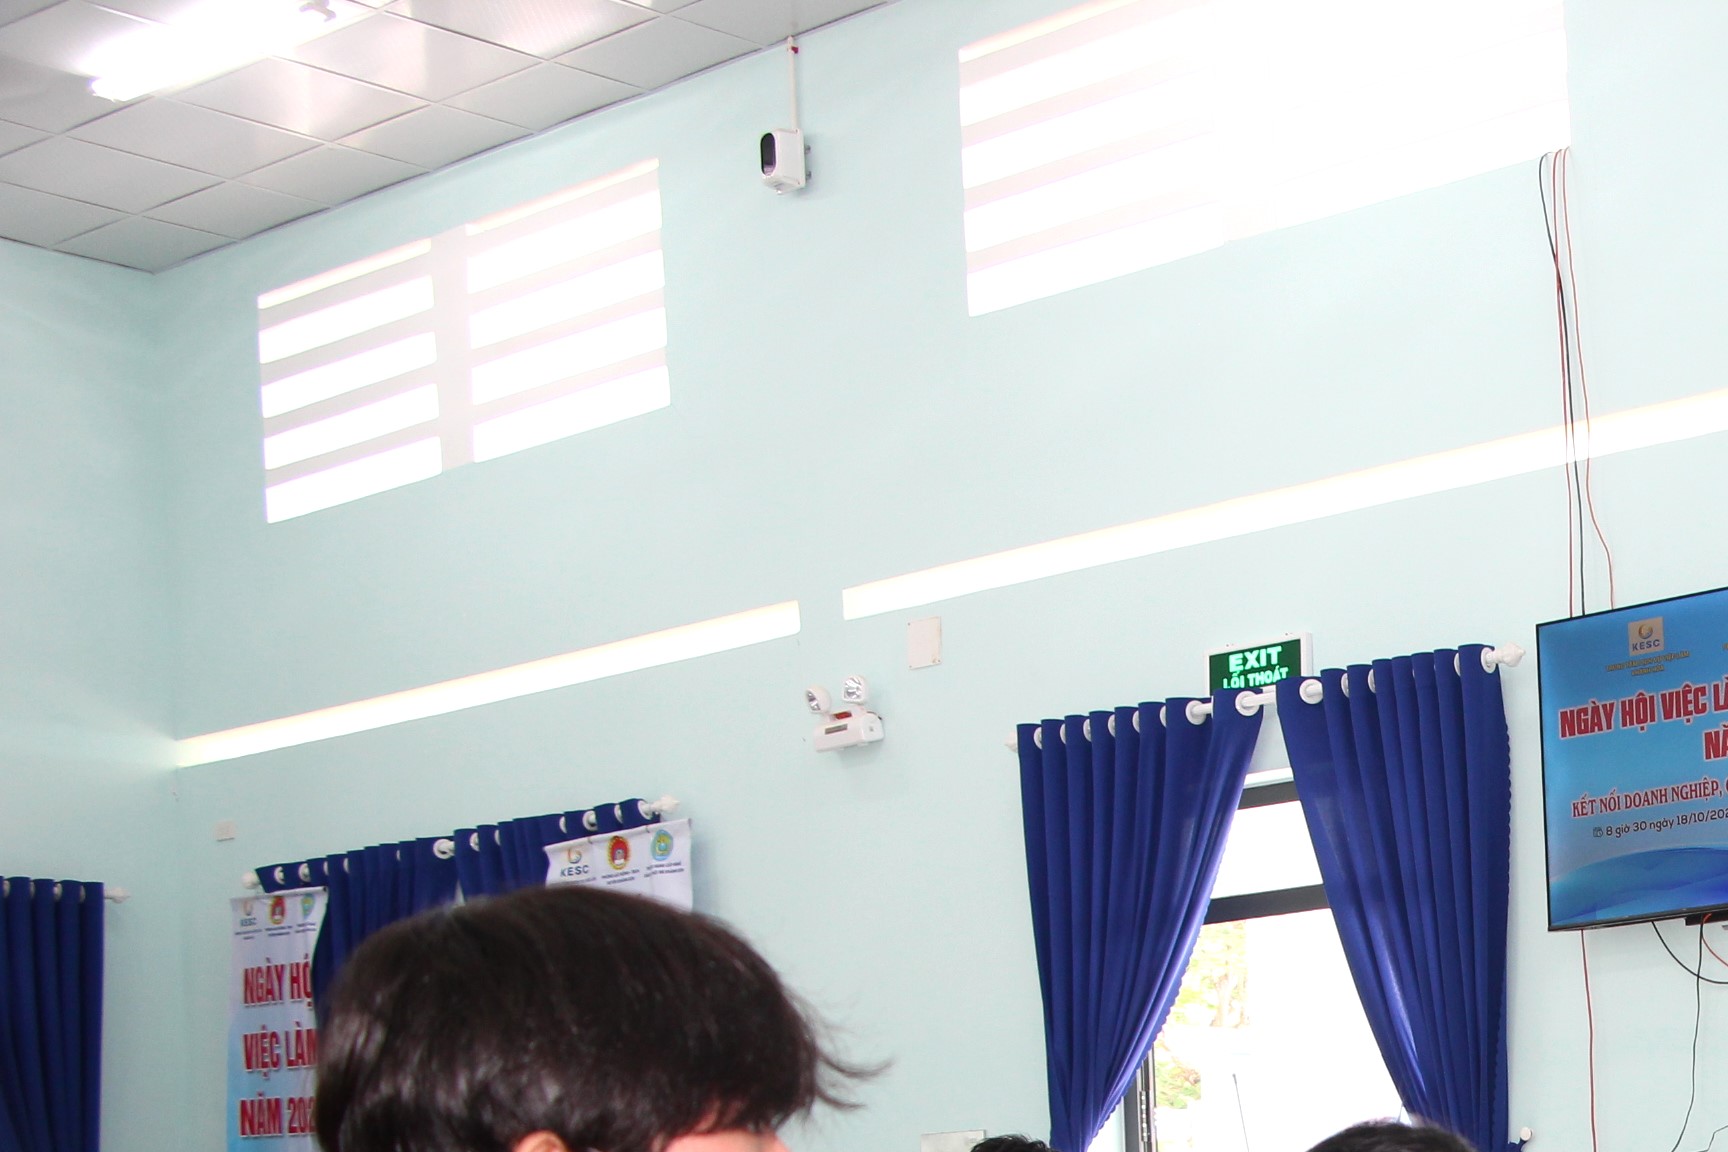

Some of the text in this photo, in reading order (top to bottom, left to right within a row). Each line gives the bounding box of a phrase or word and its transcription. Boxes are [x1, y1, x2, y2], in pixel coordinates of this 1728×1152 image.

[1228, 646, 1282, 672] EXIT
[1632, 639, 1660, 651] KESC
[1247, 666, 1288, 686] THOÁT
[1560, 701, 1615, 738] NGÀY
[1621, 692, 1655, 731] HỘI
[1661, 684, 1706, 723] VIỆC
[1572, 793, 1596, 817] KẾT
[1600, 788, 1620, 812] NỐI
[1625, 787, 1668, 808] DOANH
[1672, 778, 1722, 802] NGHIỆP,
[1606, 826, 1612, 836] 8
[1615, 823, 1630, 838] giờ
[1632, 821, 1647, 832] 30
[1650, 818, 1674, 834] ngày
[560, 865, 588, 877] KESC
[244, 957, 285, 1005] NGÀY
[244, 1024, 280, 1077] VIỆC
[240, 1091, 282, 1136] NĂM
